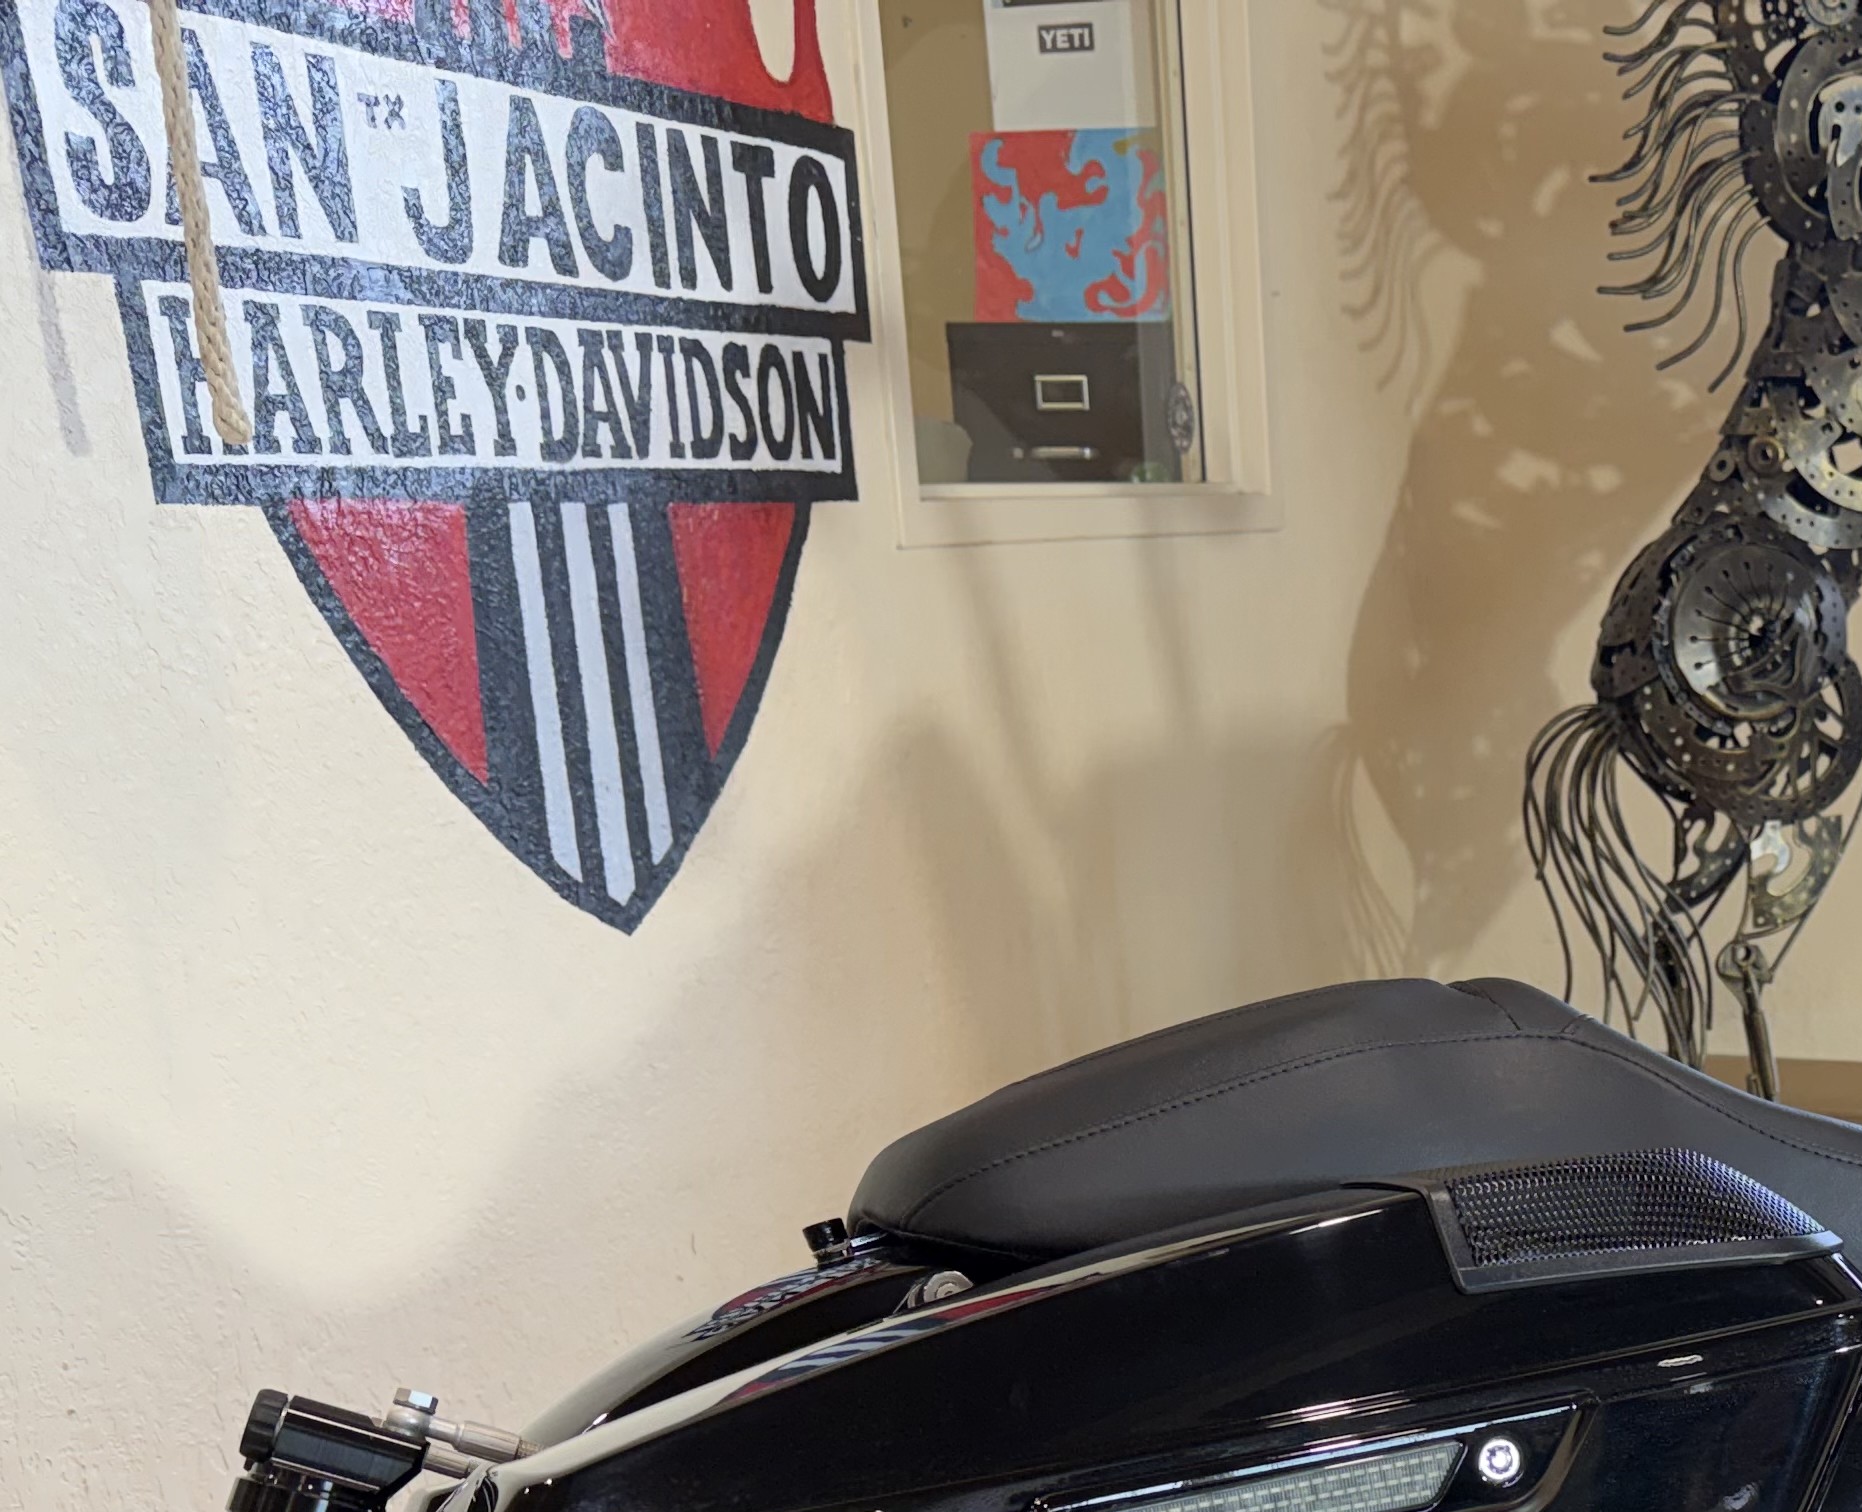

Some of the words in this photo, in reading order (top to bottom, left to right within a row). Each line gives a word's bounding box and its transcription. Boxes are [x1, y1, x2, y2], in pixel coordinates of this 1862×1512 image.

[1041, 27, 1091, 49] YETI
[54, 0, 359, 243] SAN
[404, 79, 842, 303] JACINTO
